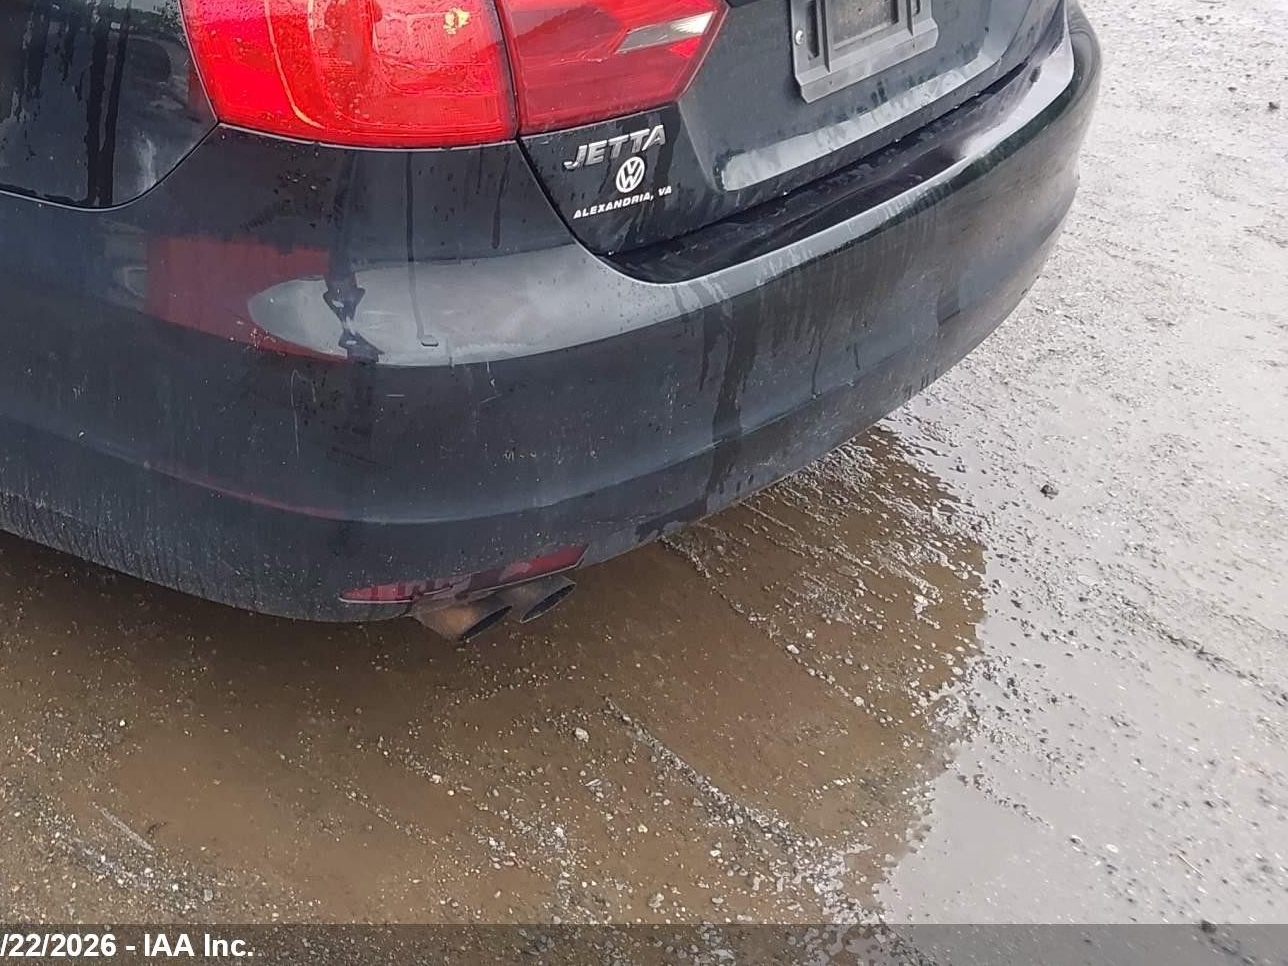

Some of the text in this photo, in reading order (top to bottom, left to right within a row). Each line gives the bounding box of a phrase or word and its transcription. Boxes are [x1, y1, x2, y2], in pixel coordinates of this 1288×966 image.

[563, 124, 666, 170] JETTA
[573, 185, 672, 219] ALEXANDRIA, VA
